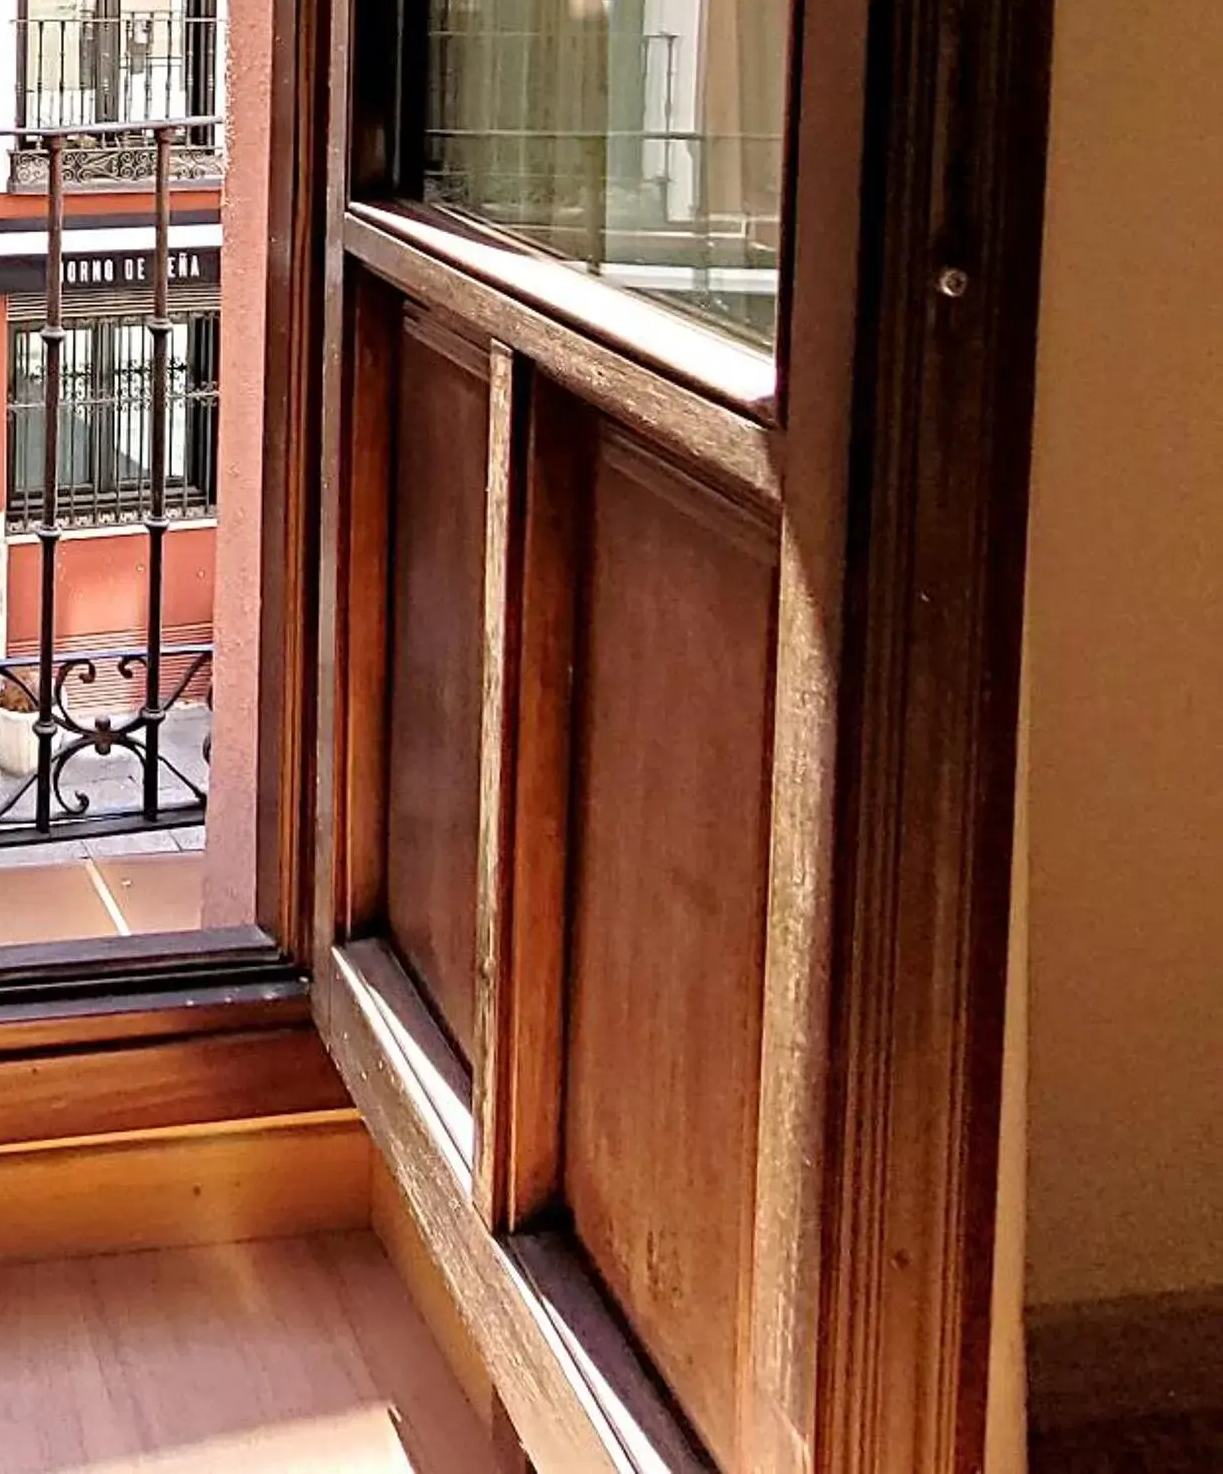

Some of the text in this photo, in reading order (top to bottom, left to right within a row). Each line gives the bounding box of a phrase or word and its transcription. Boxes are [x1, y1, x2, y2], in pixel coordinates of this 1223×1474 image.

[61, 252, 200, 284] ORNO DE EÑA
